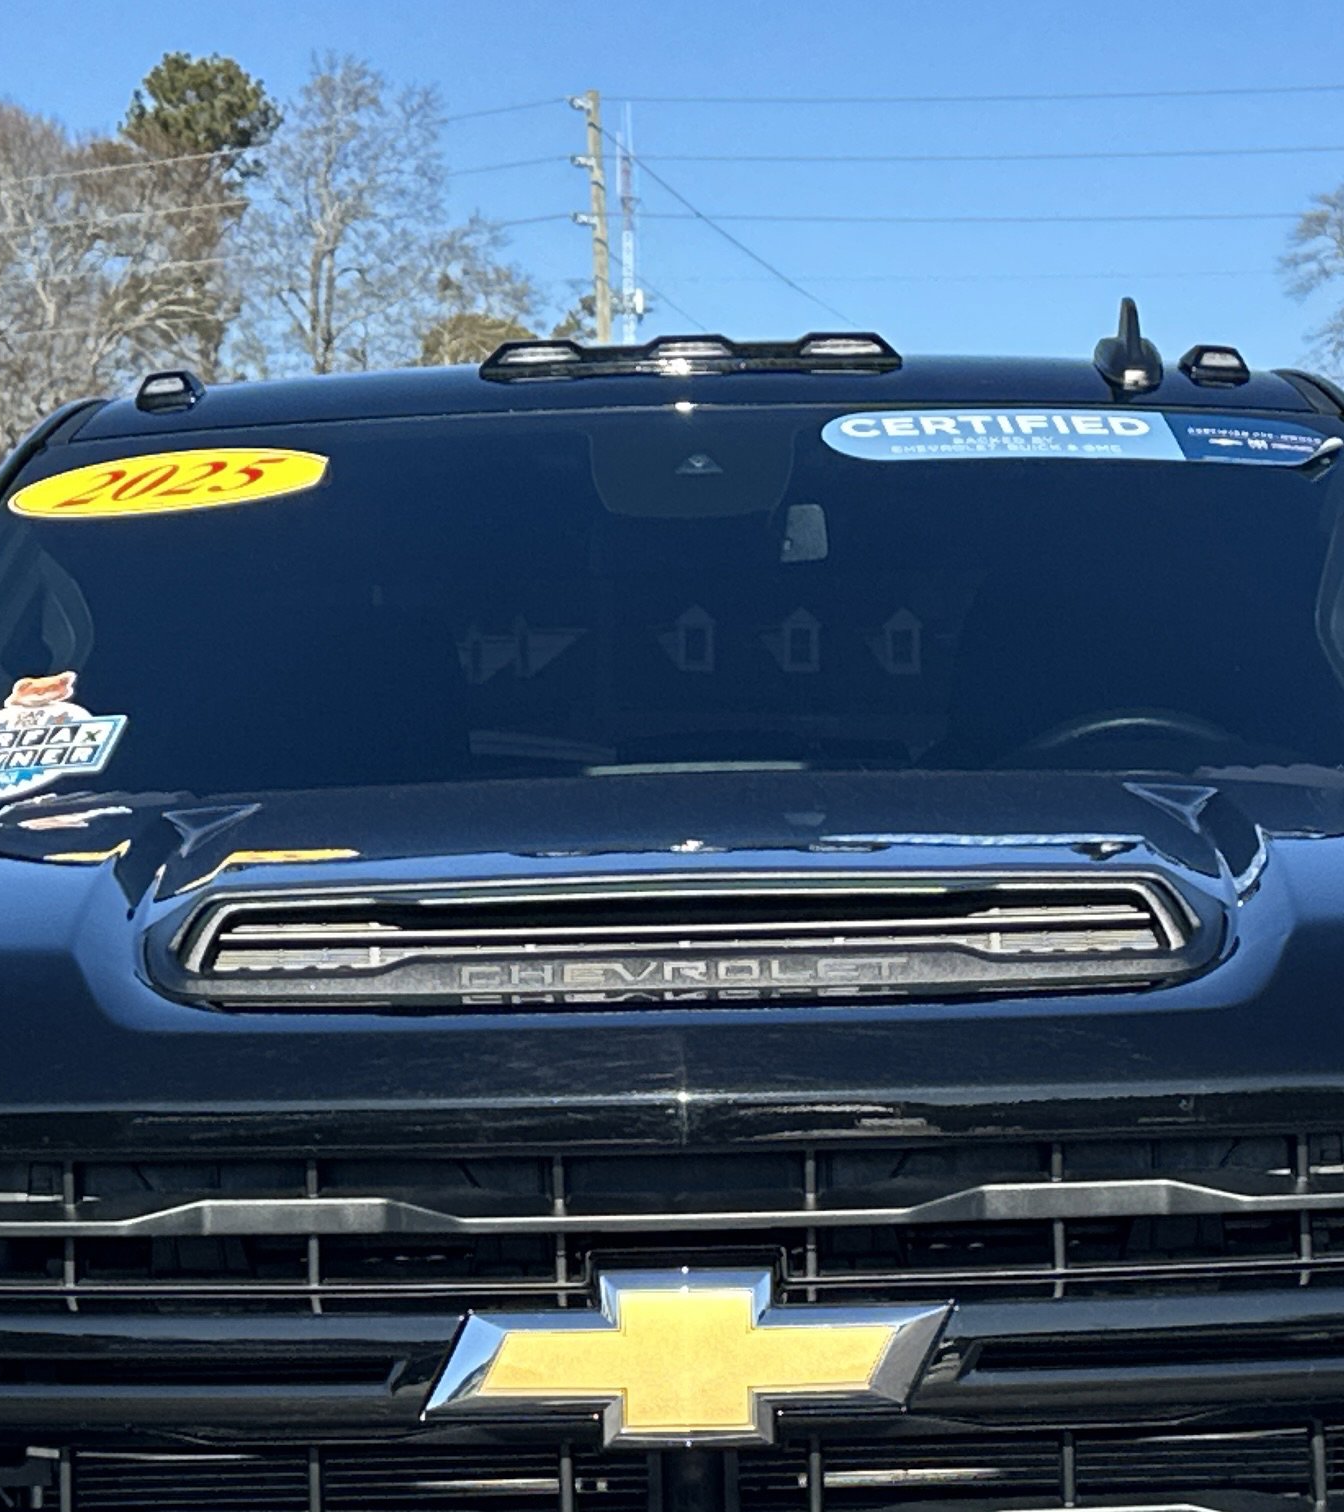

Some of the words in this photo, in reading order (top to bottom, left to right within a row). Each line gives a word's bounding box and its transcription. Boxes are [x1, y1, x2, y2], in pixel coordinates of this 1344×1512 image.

[839, 414, 1151, 437] CERTIFIED
[952, 436, 1025, 444] BACKED
[1032, 436, 1055, 444] BY
[52, 457, 289, 509] 2025
[459, 957, 910, 987] CHEVROLET
